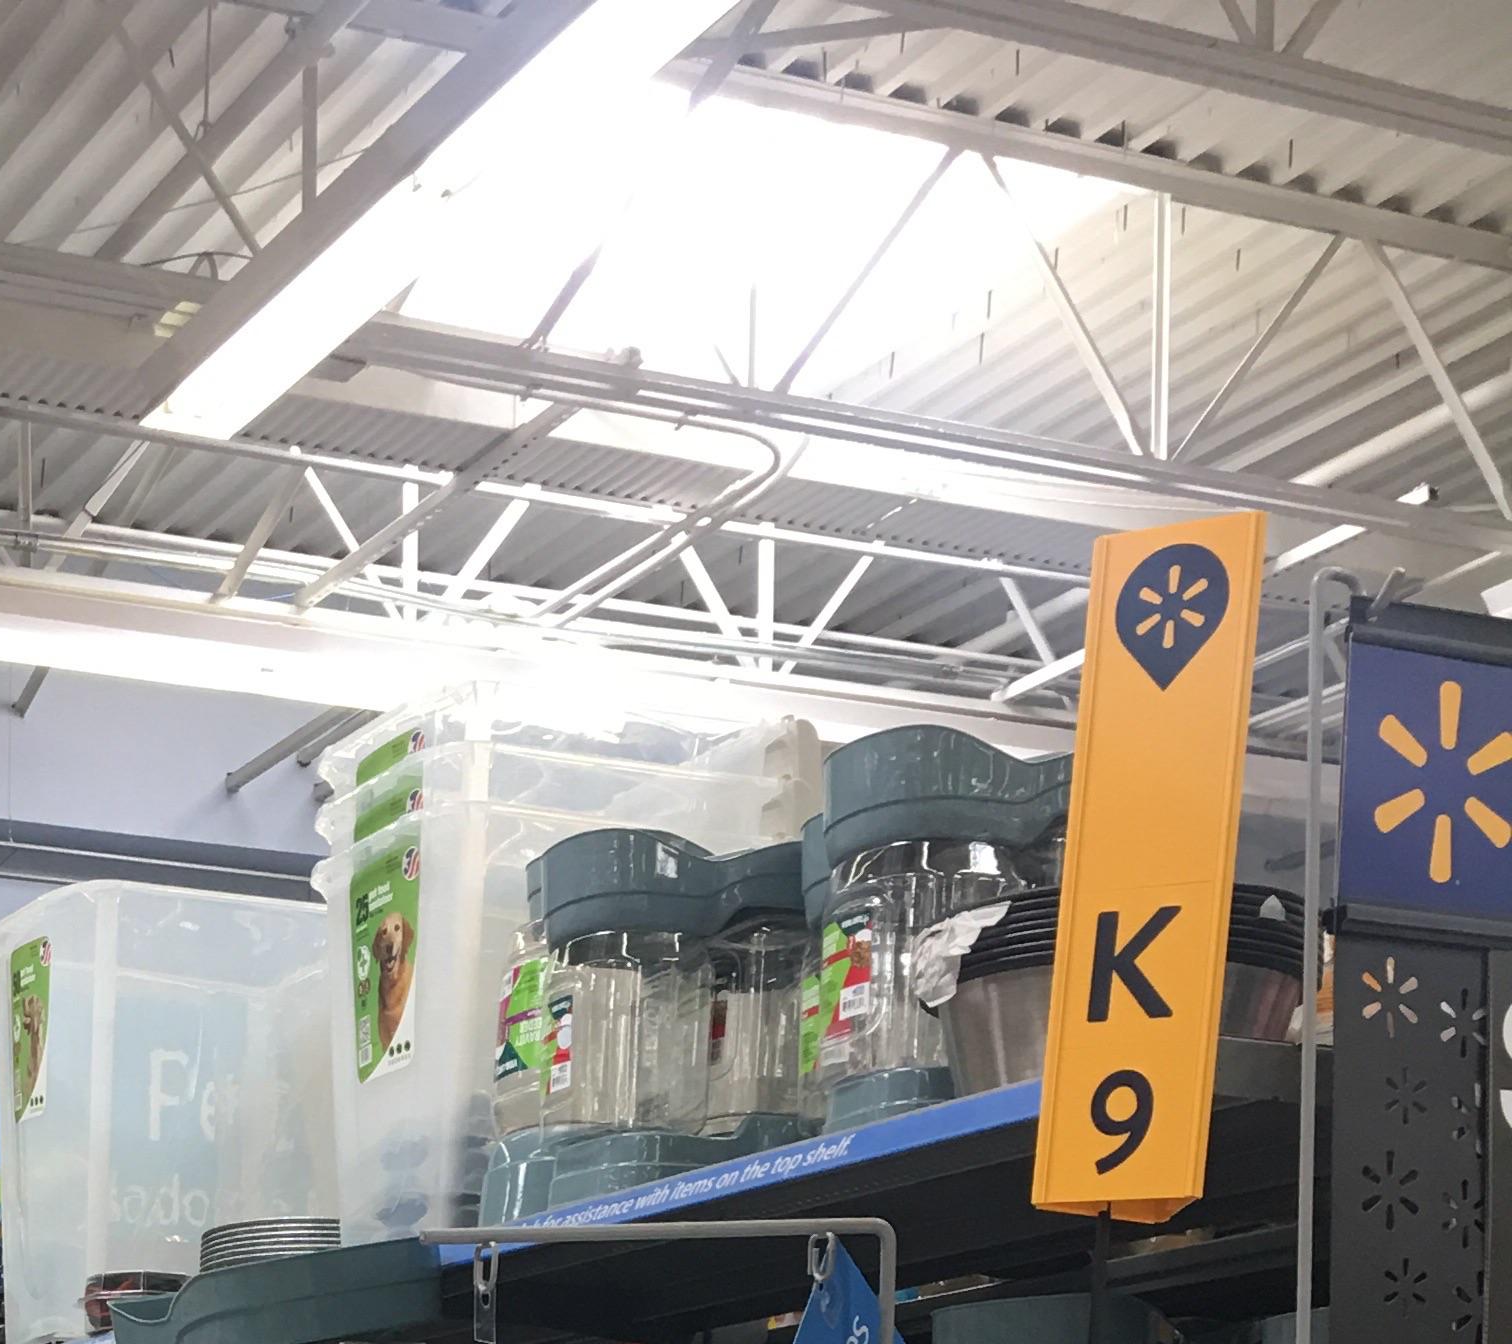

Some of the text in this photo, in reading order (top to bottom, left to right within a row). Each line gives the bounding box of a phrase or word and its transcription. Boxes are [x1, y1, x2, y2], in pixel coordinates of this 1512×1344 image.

[1087, 905, 1182, 1022] K
[1091, 1069, 1154, 1174] 9
[564, 1199, 634, 1226] assistance
[635, 1186, 669, 1212] with
[670, 1175, 714, 1201] items
[715, 1171, 739, 1189] on
[740, 1159, 770, 1183] the
[772, 1153, 803, 1179] top
[802, 1133, 854, 1167] shelf.
